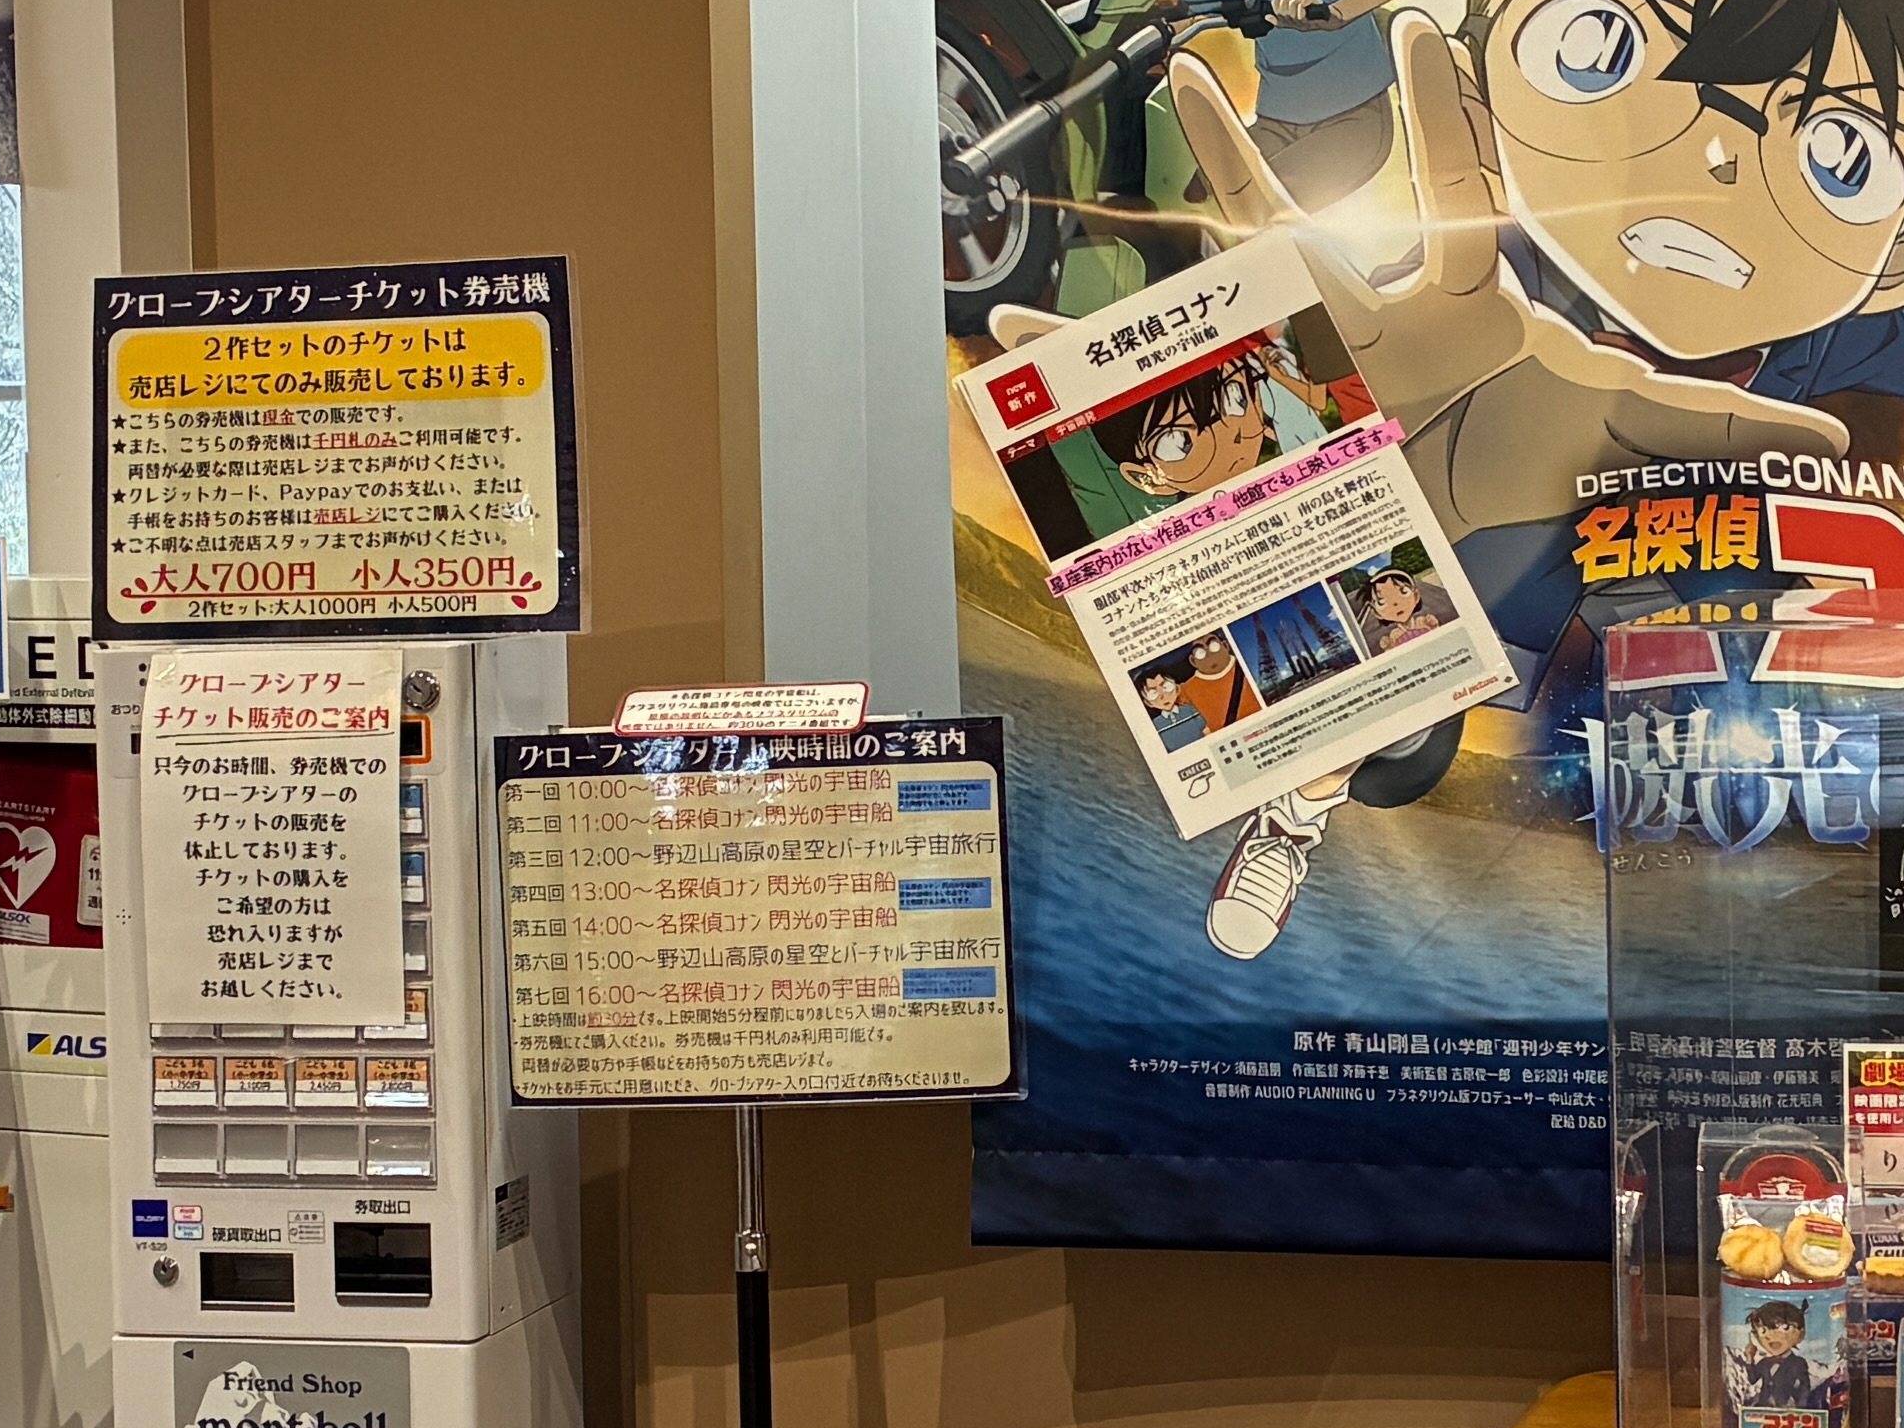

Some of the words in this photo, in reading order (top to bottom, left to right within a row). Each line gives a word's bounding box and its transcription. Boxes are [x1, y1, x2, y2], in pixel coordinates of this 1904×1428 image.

[108, 271, 551, 320] グローブシアターチケット券売機
[1083, 281, 1242, 368] 名探偵コナン
[1135, 326, 1221, 372] 閃光の宇宙船
[129, 364, 529, 400] 売店レジにてのみ販売しております。
[1008, 390, 1039, 414] 新作
[1007, 439, 1037, 459] テーマ
[1576, 459, 1758, 500] DETECTIVE
[1572, 492, 1761, 583] 名探偵
[151, 560, 317, 593] 大人700円
[351, 556, 517, 588] 小人350円
[388, 594, 477, 614] 小人500円
[179, 672, 366, 695] グローブシアター
[153, 706, 390, 730] チケット販売のご案内
[154, 756, 386, 777] 只今のお時間、券売機での
[183, 784, 358, 804] グローブシアターの
[504, 782, 560, 802] 第一回
[763, 768, 891, 794] 閃光の宇宙船
[193, 812, 347, 832] チケットの販売を
[507, 814, 561, 834] 第二回
[765, 801, 893, 826] 閃光の宇宙船
[184, 841, 349, 861] 休止しております。
[509, 849, 563, 869] 第三回
[196, 869, 349, 888] チケットの購入を
[510, 884, 565, 903] 第四回
[767, 872, 897, 895] 閃光の宇宙船
[216, 896, 331, 915] ご希望の方は
[512, 919, 567, 938] 第五回
[768, 907, 898, 931] 閃光の宇宙船
[207, 924, 343, 943] 恐れ入りますが
[218, 952, 333, 971] 売店レジまで
[514, 953, 568, 972] 第六回
[201, 980, 346, 999] お越しください。
[516, 987, 570, 1005] 第七回
[771, 976, 900, 1000] 閃光の宇宙船
[1294, 1031, 1336, 1052] 原作
[1129, 1058, 1232, 1076] キャラクターデザイン
[1292, 1061, 1339, 1078] 作画監督
[1401, 1065, 1448, 1082] 美術監督
[1522, 1067, 1569, 1084] 色彩設計
[1255, 1085, 1295, 1100] AUDIO
[1298, 1086, 1364, 1101] PLANNING
[1365, 1087, 1376, 1101] U
[1550, 1114, 1576, 1129] 配給
[1579, 1115, 1607, 1130] D&D
[355, 1200, 411, 1215] 券取出口
[212, 1227, 282, 1242] 硬貨取出口
[223, 1371, 294, 1393] Friend
[302, 1373, 362, 1398] Shop
